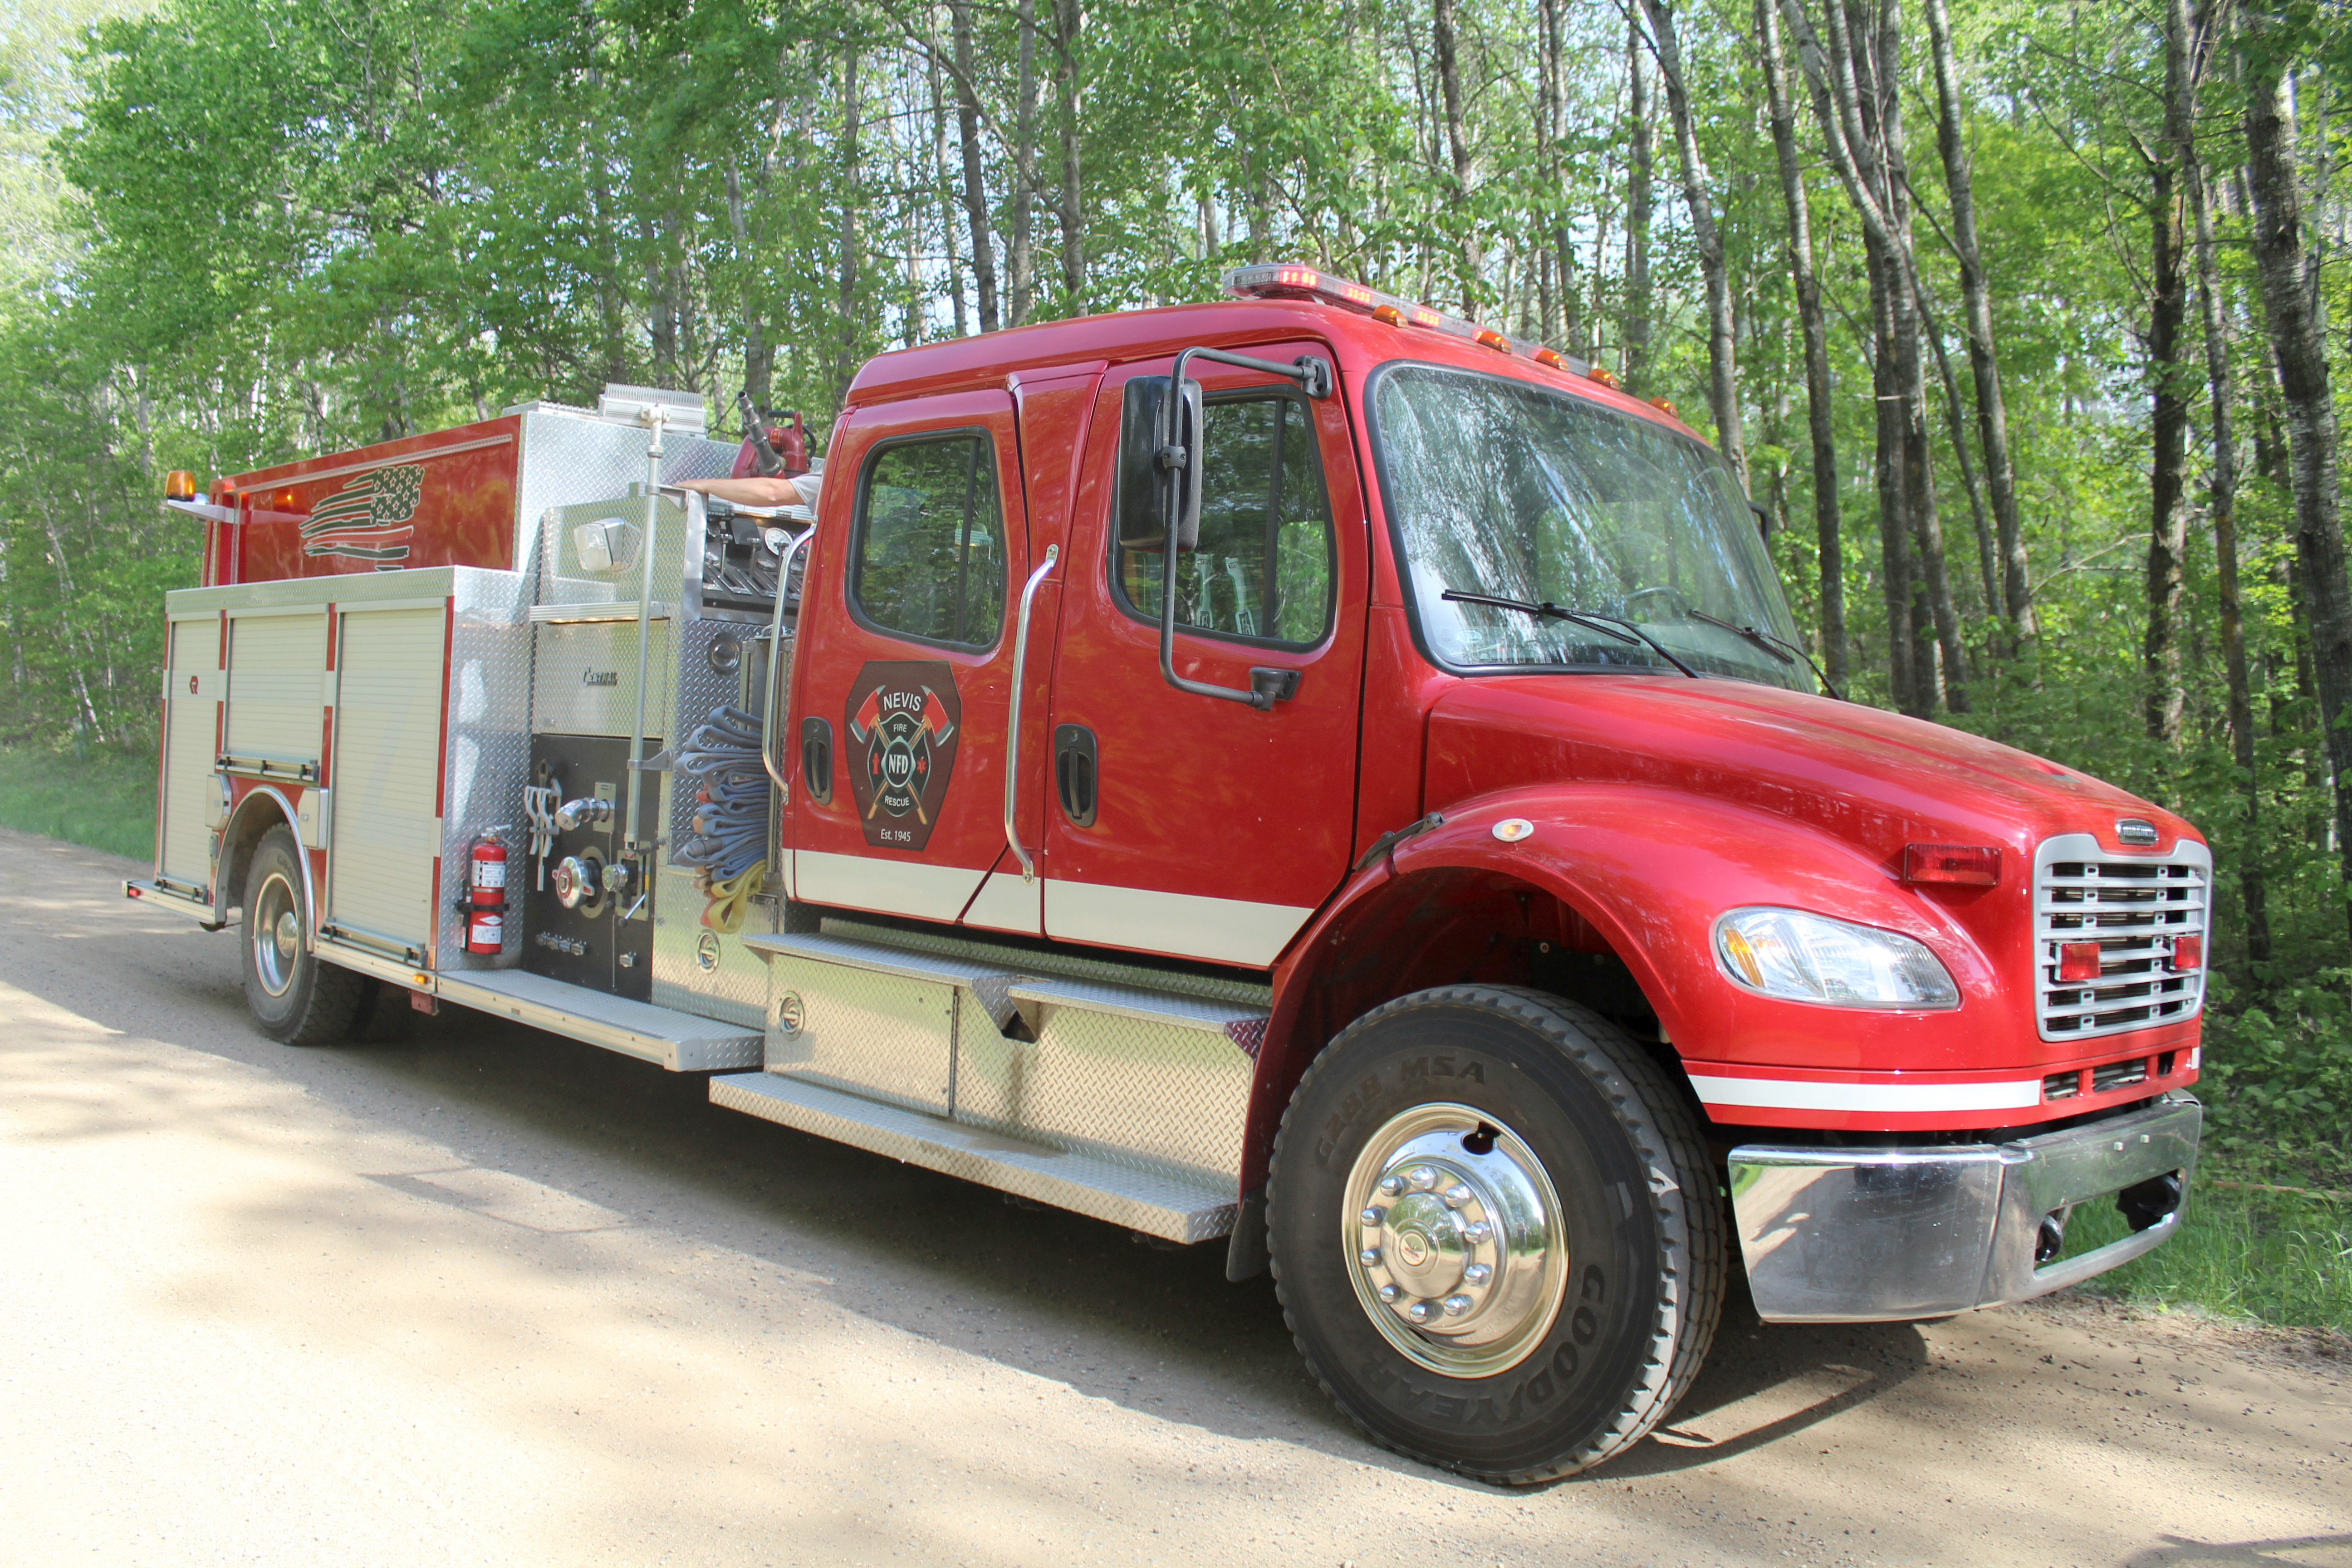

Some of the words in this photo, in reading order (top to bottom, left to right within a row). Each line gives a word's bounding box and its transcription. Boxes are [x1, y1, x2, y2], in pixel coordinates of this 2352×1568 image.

[883, 692, 921, 712] NEVIS
[893, 723, 907, 733] FIRE
[888, 754, 909, 774] NFD
[884, 795, 910, 807] RESCUE
[881, 828, 892, 840] Est.
[894, 830, 911, 842] 1945
[1401, 1055, 1485, 1087] MSA
[1360, 1264, 1605, 1426] GOODYEAR
